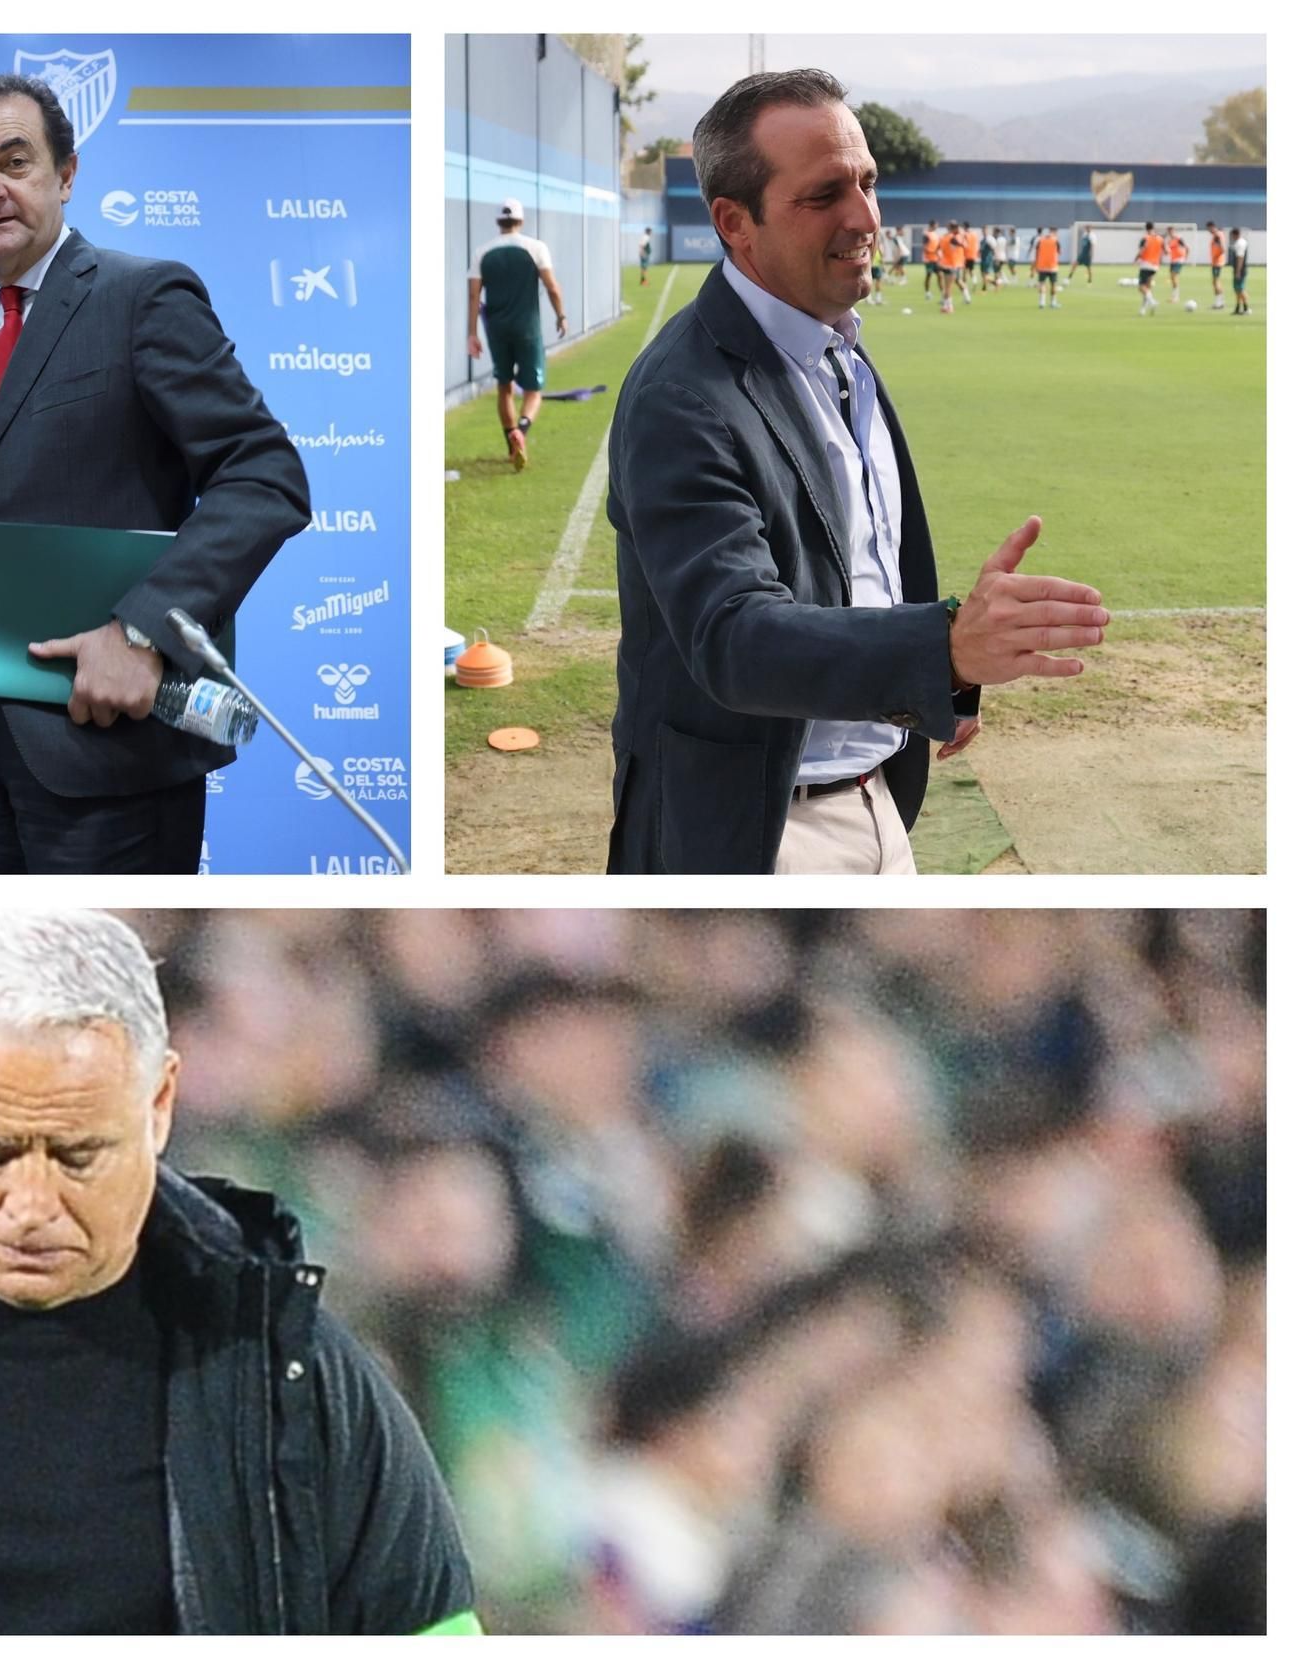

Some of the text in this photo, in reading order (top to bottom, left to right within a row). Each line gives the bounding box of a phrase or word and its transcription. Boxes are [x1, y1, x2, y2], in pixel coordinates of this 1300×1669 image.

[144, 190, 199, 204] COSTA
[144, 204, 201, 215] DEL SOL
[266, 199, 348, 219] LALIGA
[304, 509, 378, 533] ALIGA
[313, 702, 380, 720] hummel
[342, 757, 406, 772] COSTA
[343, 774, 408, 787] DEL SOL
